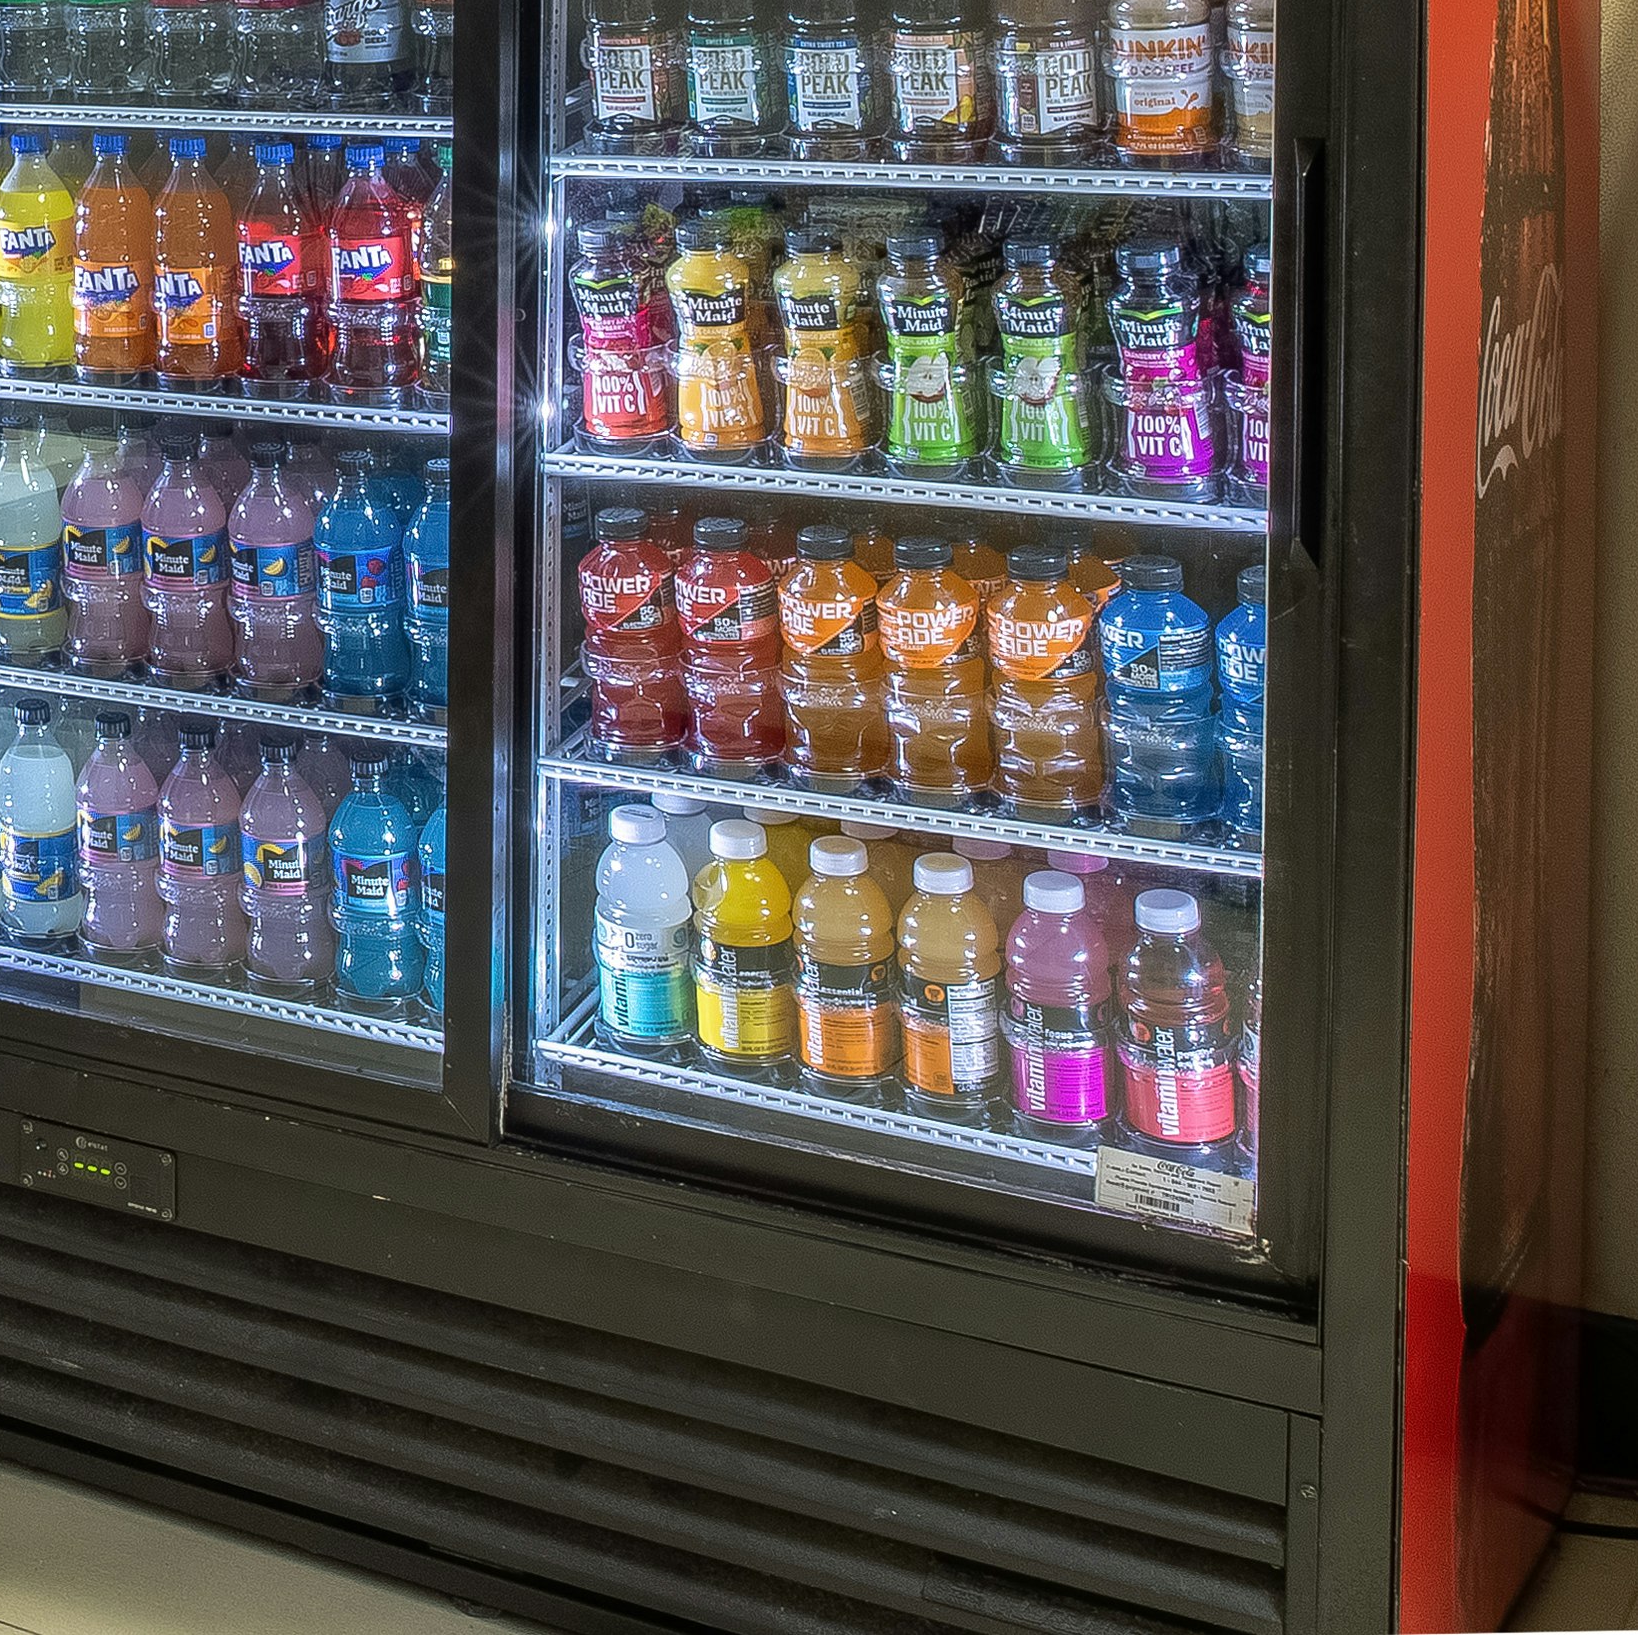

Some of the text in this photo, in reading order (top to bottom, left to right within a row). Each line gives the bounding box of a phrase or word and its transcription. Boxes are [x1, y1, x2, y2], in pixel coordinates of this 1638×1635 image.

[600, 71, 646, 90] PEAK
[699, 71, 747, 90] PEAK
[801, 74, 852, 95] PEAK
[1045, 75, 1094, 99] PEAK
[1134, 94, 1176, 108] original
[0, 226, 55, 251] FANTA
[332, 244, 392, 270] FANTA
[74, 266, 139, 293] FANTA
[582, 302, 627, 315] Maid
[687, 296, 744, 311] Minute
[896, 305, 949, 321] Minute
[694, 309, 737, 323] Maid
[903, 318, 944, 334] Maid
[1008, 318, 1056, 334] Maid
[1121, 317, 1183, 336] Minute
[1127, 331, 1175, 349] Maid
[595, 374, 635, 394] 100%
[597, 394, 636, 414] VIT C
[797, 395, 835, 414] 100%
[797, 417, 836, 437] VIT C
[913, 422, 952, 442] VIT C
[1135, 414, 1181, 435] 100%
[1136, 436, 1183, 458] VIT C
[70, 541, 103, 554] Minute
[74, 551, 99, 564] Maid
[154, 552, 190, 565] Minute
[159, 563, 185, 575] Maid
[581, 570, 653, 595] POWER
[713, 618, 739, 628] 50%
[896, 607, 974, 629] POWER
[897, 627, 946, 646] ADE
[998, 619, 1084, 644] POWER
[998, 638, 1049, 659] ADE
[170, 851, 194, 863] Maid
[273, 867, 302, 880] Maid
[351, 874, 391, 888] Minute
[355, 884, 385, 897] Maid
[624, 932, 654, 950] 0 zero
[635, 941, 659, 952] sugar
